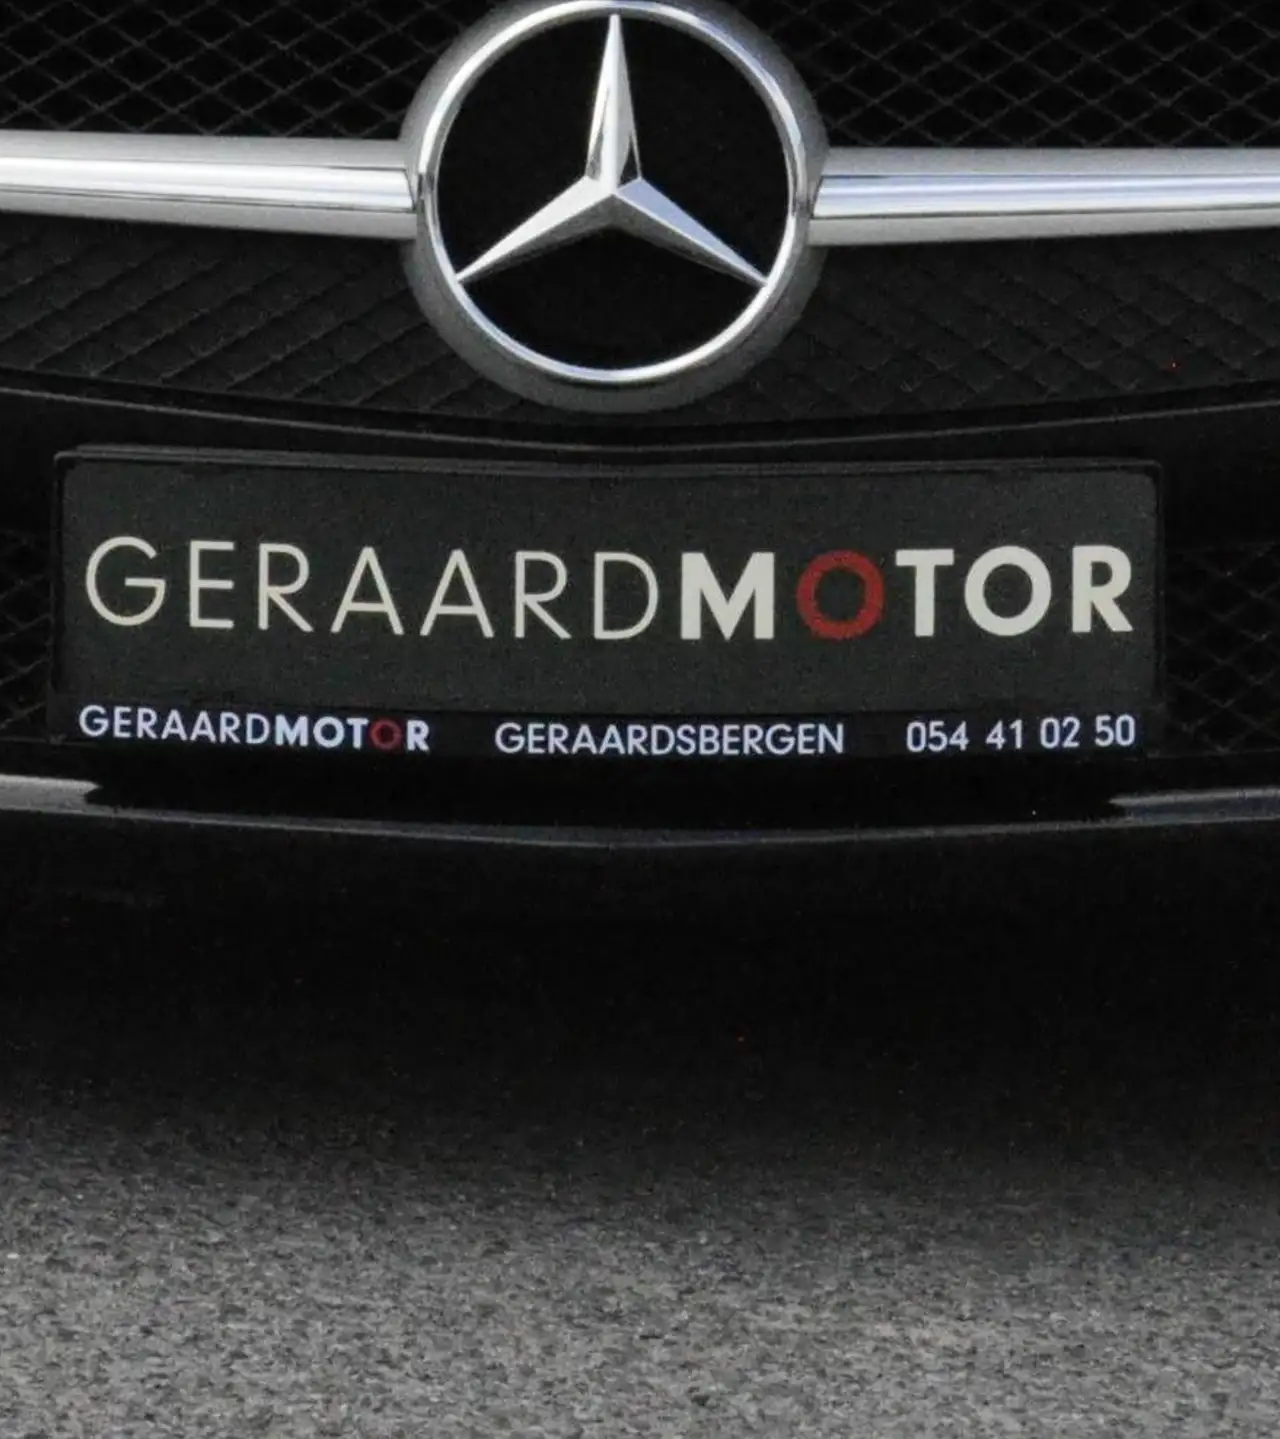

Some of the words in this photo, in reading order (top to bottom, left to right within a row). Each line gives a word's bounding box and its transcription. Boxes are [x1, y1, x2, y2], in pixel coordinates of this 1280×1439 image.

[86, 536, 1134, 641] GERAARDMOTOR
[79, 704, 431, 752] GERAARDMOTOR
[494, 721, 845, 756] GERAARDSBERGEN
[906, 720, 970, 752] 054
[985, 719, 1024, 750] 41
[1039, 716, 1081, 749] 02
[1094, 713, 1136, 747] 50
